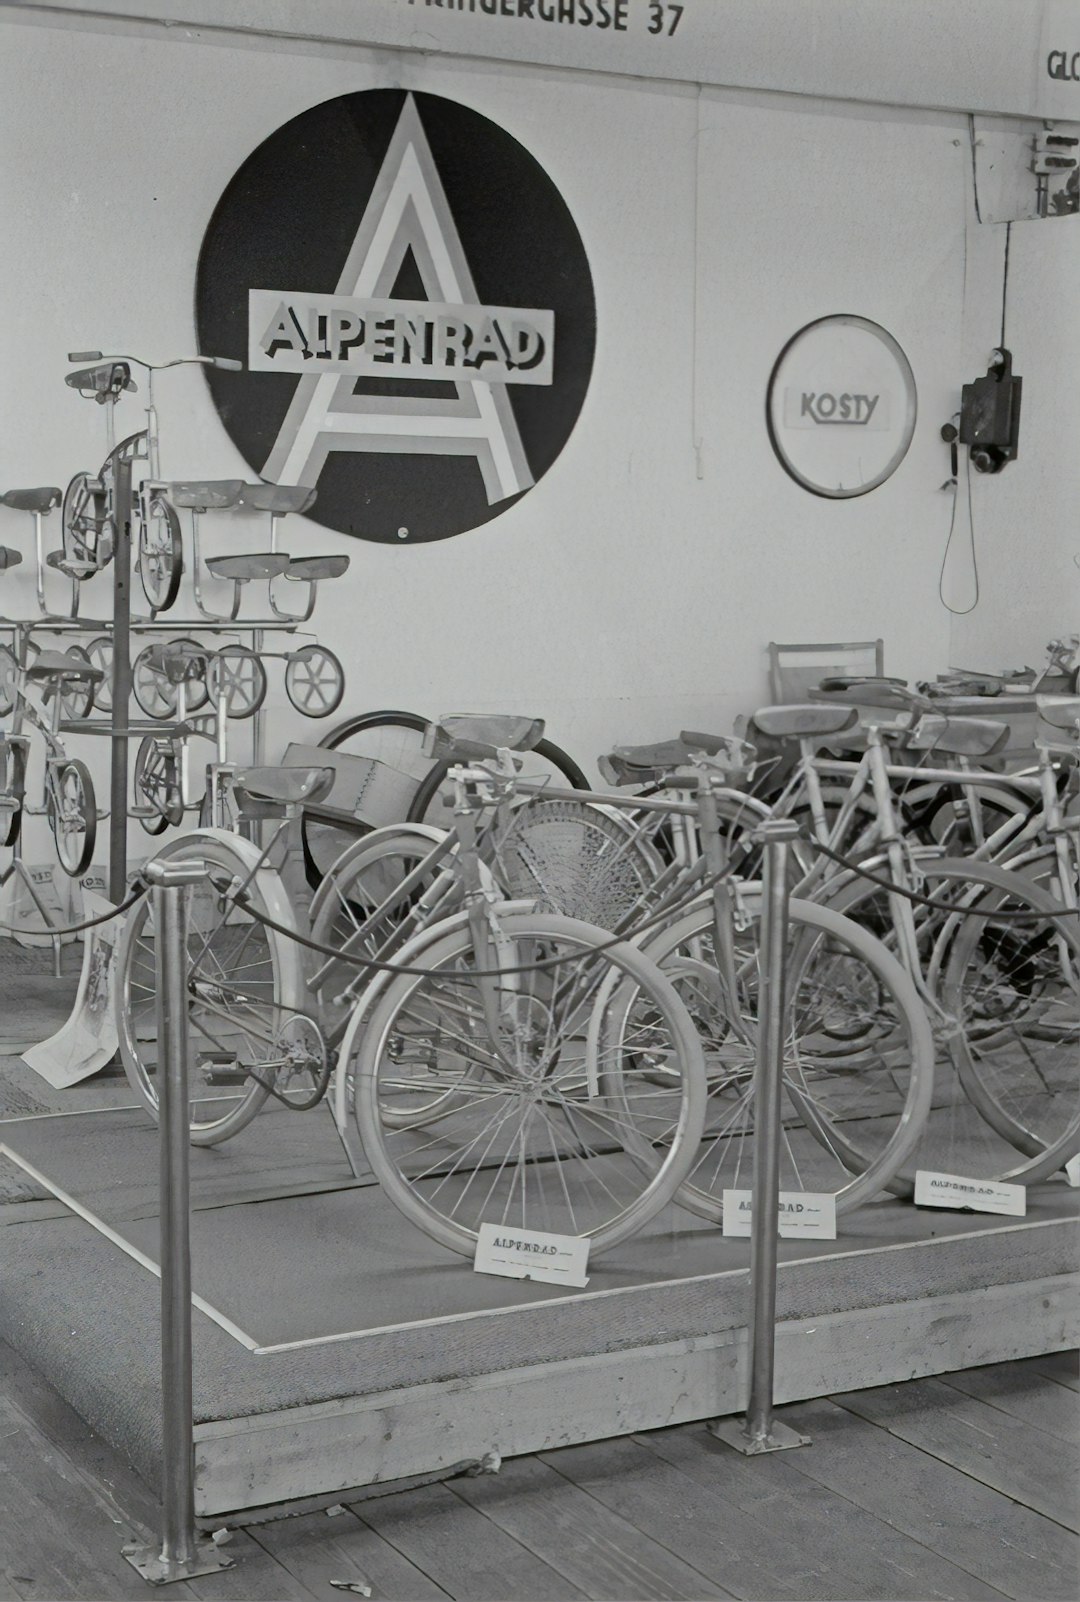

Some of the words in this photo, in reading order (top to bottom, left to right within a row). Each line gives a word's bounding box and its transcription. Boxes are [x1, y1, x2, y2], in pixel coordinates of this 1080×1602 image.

[647, 4, 684, 36] 37
[258, 301, 546, 371] ALPENRAD
[801, 392, 880, 424] KOSTY
